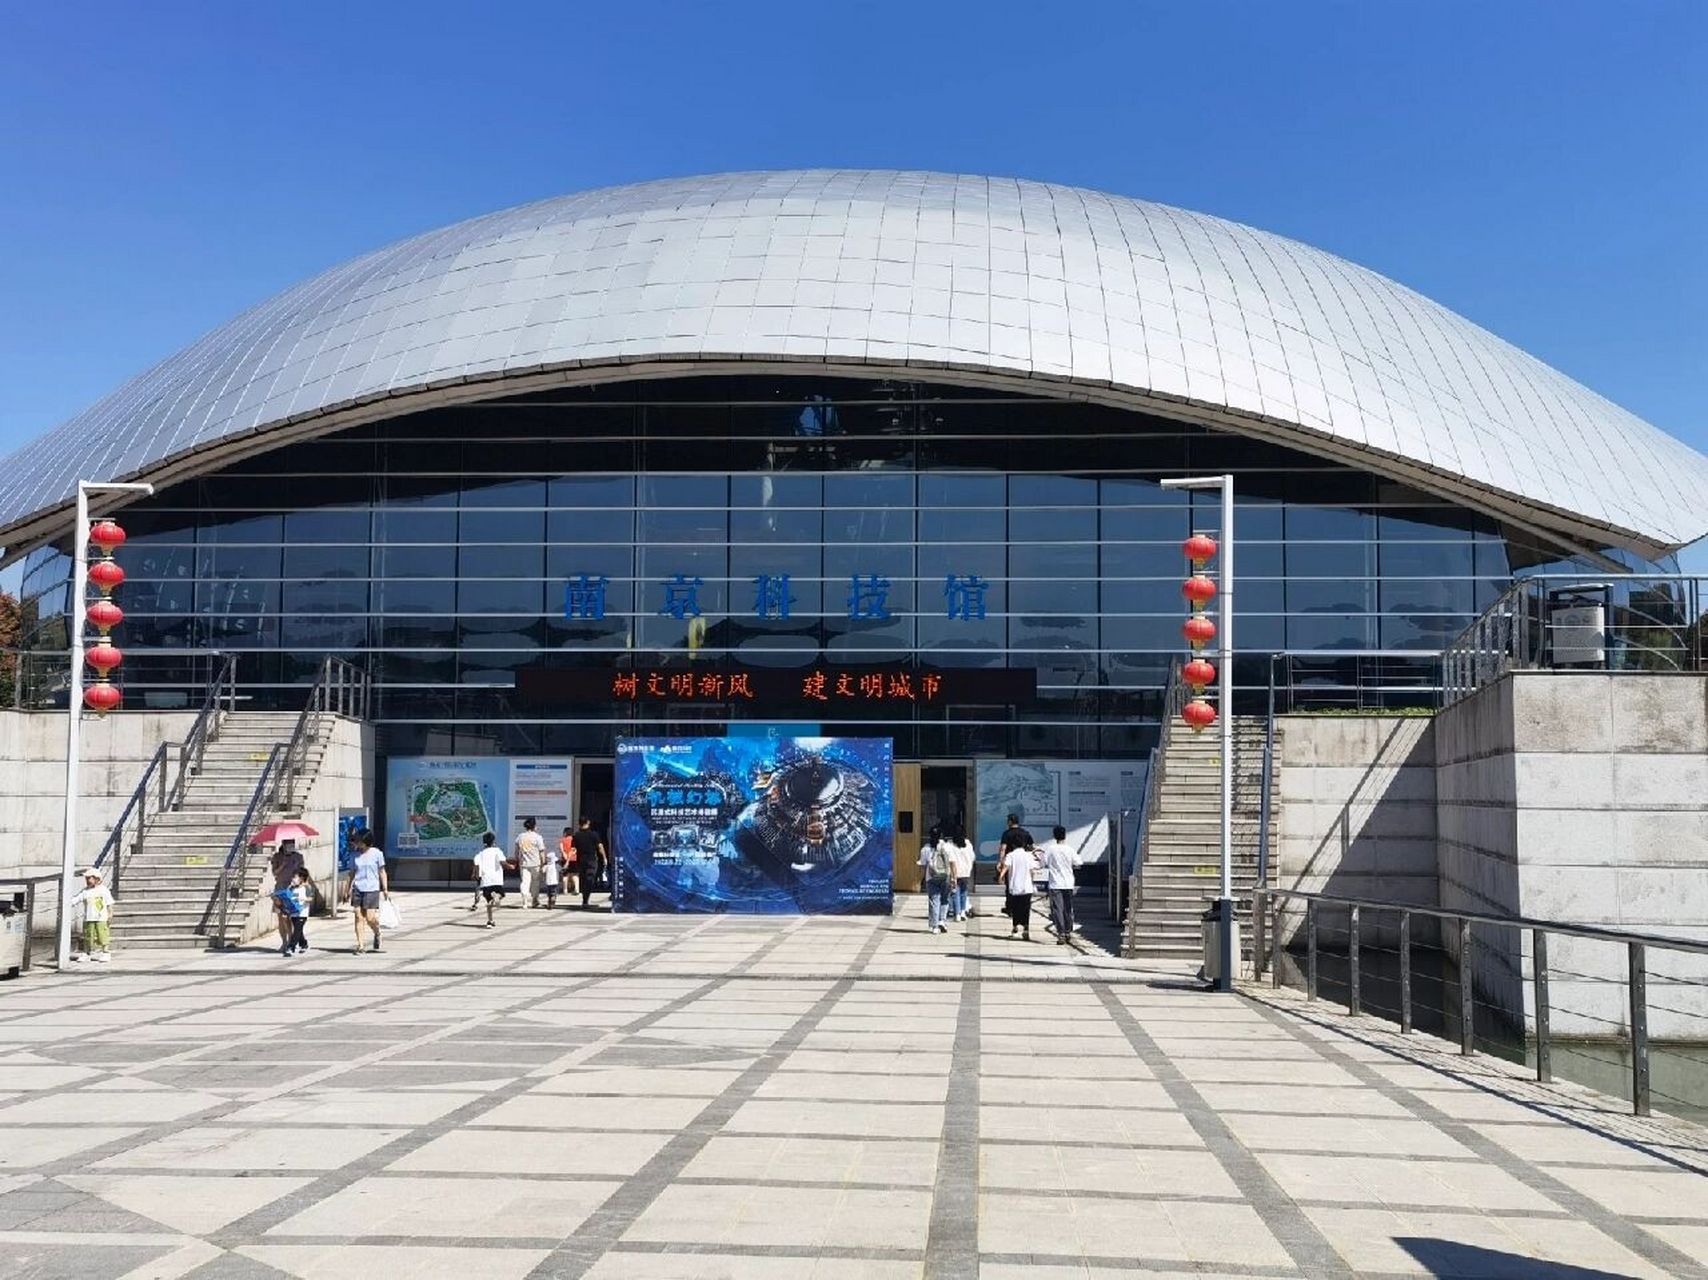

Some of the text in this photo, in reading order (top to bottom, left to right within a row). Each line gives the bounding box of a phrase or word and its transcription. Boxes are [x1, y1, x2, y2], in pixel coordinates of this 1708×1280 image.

[564, 574, 989, 621] 南京科技馆
[613, 671, 942, 700] 树文明新风 建文明城市
